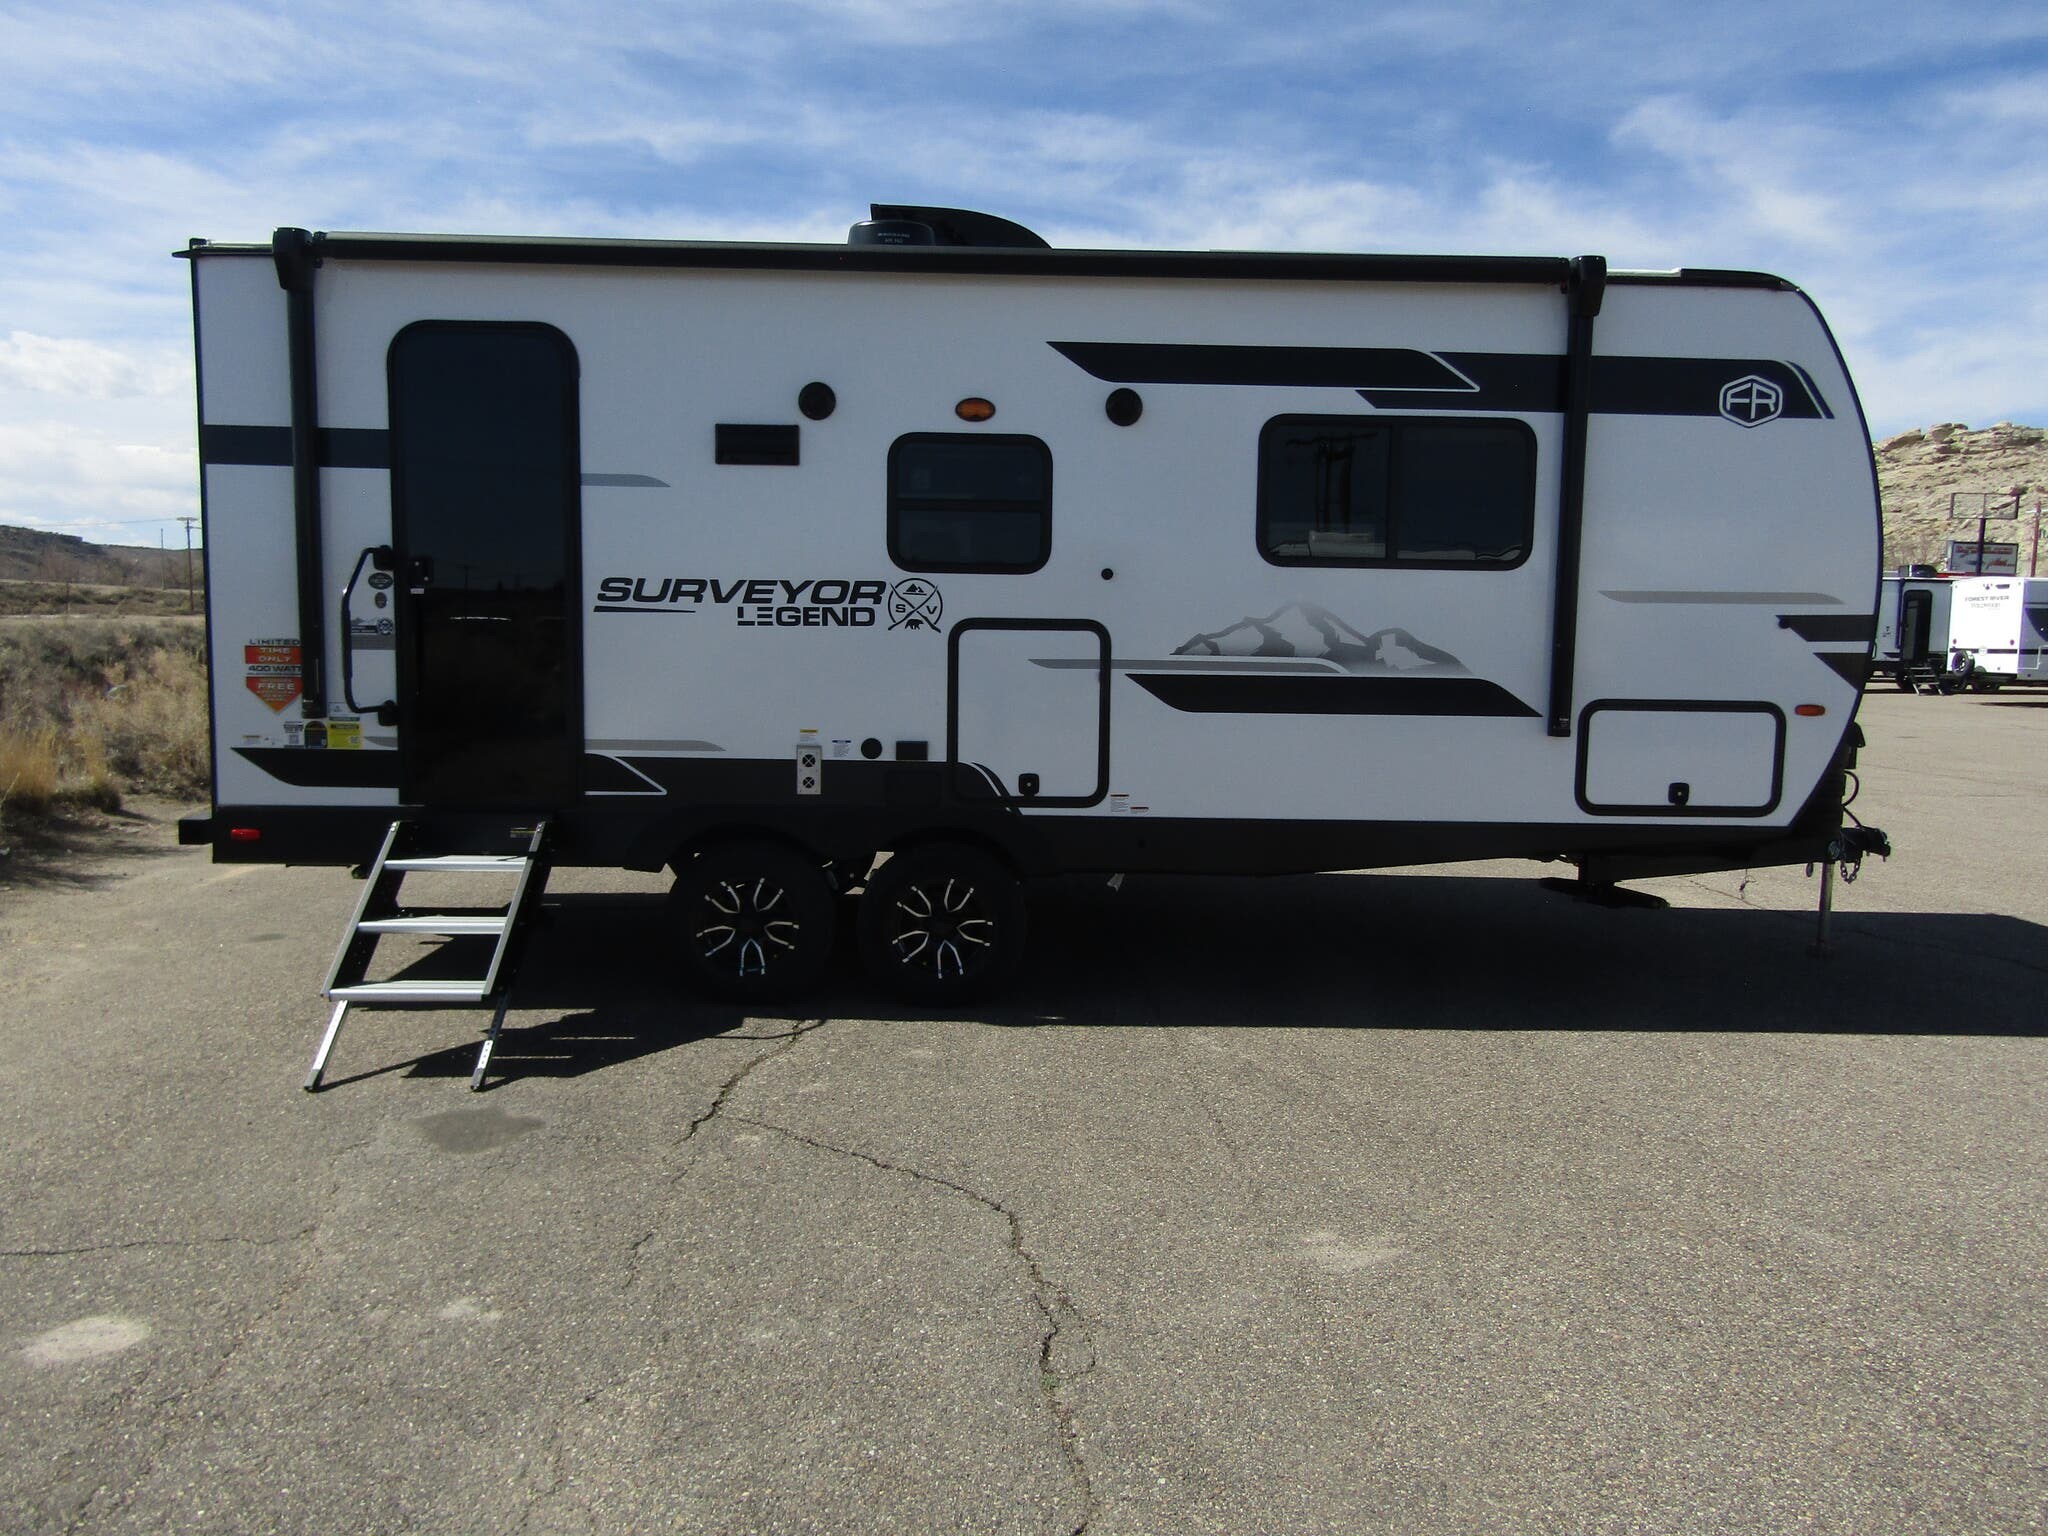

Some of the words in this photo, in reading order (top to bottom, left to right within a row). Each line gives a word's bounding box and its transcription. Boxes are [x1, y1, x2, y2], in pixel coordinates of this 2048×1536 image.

[597, 577, 887, 604] SURVEYOR
[736, 605, 877, 627] LEGEND
[895, 603, 907, 614] S
[925, 605, 938, 615] V
